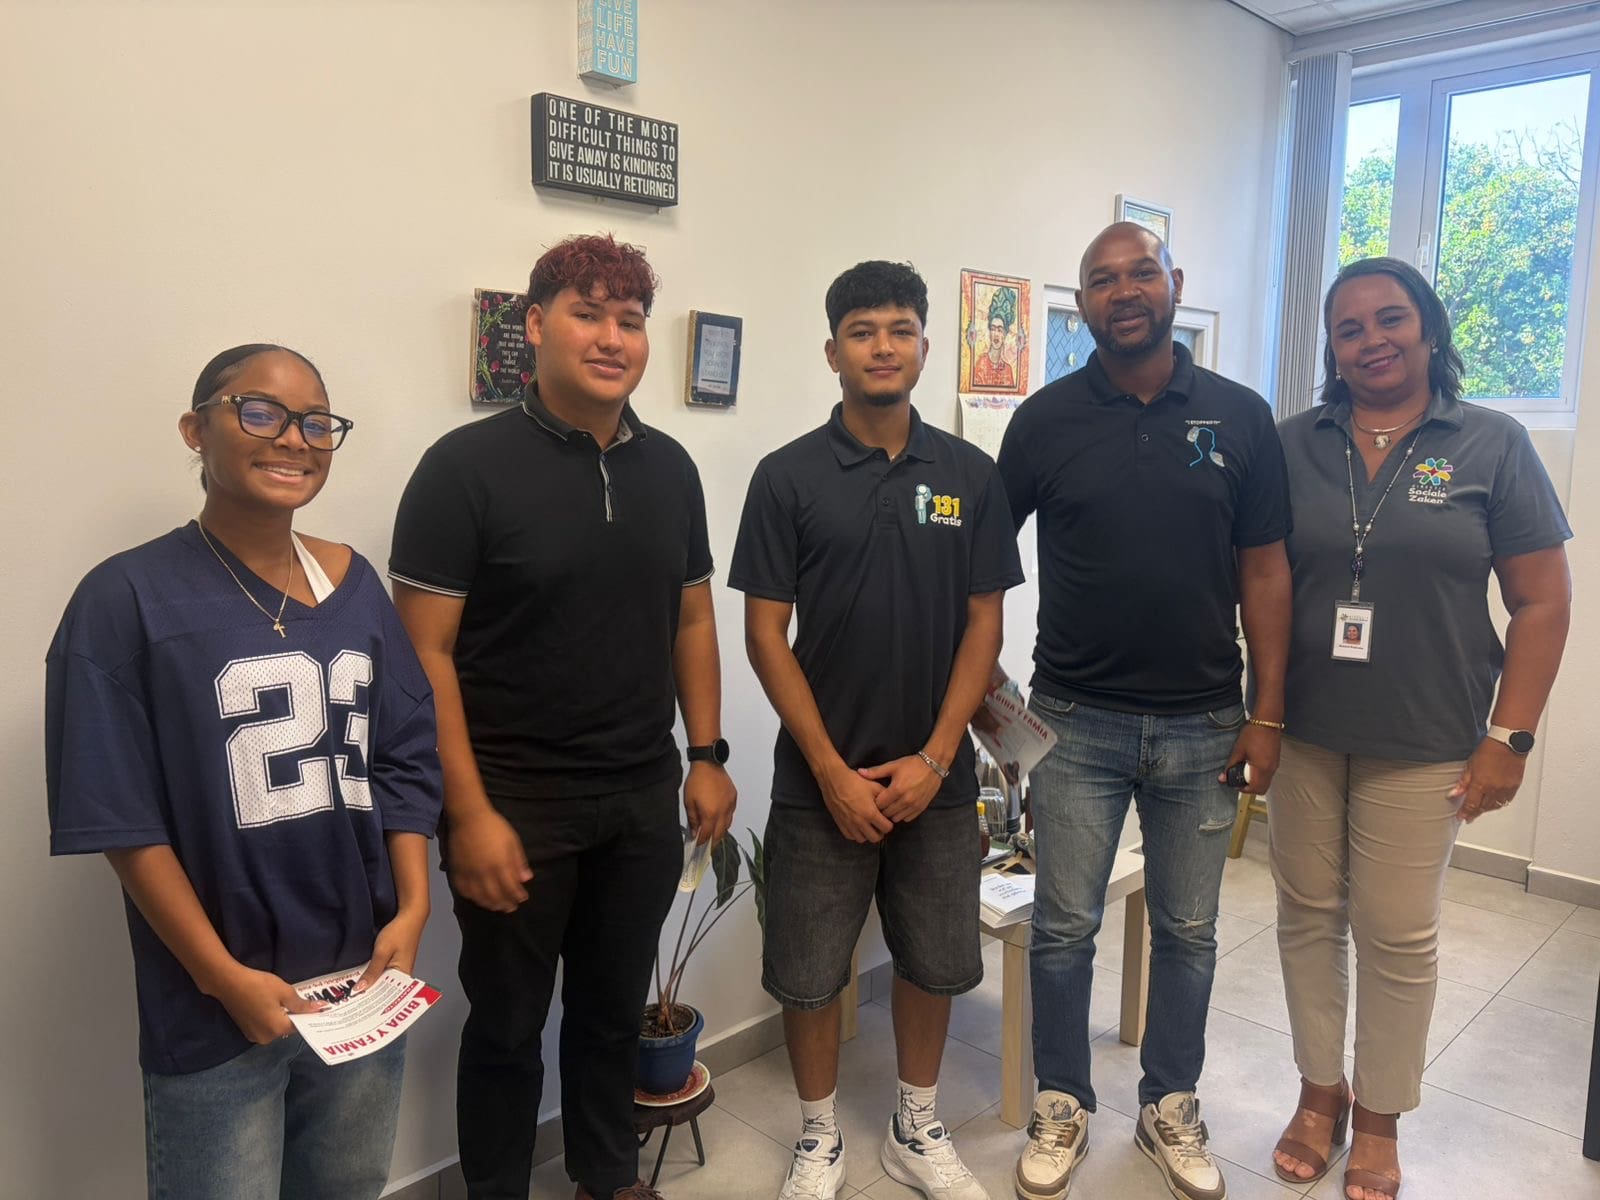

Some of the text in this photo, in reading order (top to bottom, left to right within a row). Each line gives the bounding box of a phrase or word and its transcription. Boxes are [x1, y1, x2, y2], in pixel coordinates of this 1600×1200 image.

[596, 7, 633, 38] LIFE
[596, 30, 634, 56] HAVE
[597, 48, 632, 78] FUN
[549, 98, 676, 142] ONE OF THE MOST
[549, 119, 676, 162] DIFFICULT THINGS TO
[549, 140, 675, 182] GIVE AWAY IS KINDNESS,
[550, 160, 676, 200] IT IS USUALLY RETURNED
[932, 494, 960, 518] 131
[1408, 488, 1447, 498] Sociale
[1408, 494, 1444, 504] Zaken
[930, 513, 962, 527] Gratis
[214, 649, 374, 829] 23
[386, 1000, 420, 1028] BIDA
[322, 1034, 376, 1056] FAMIA
[376, 1028, 388, 1038] Y
